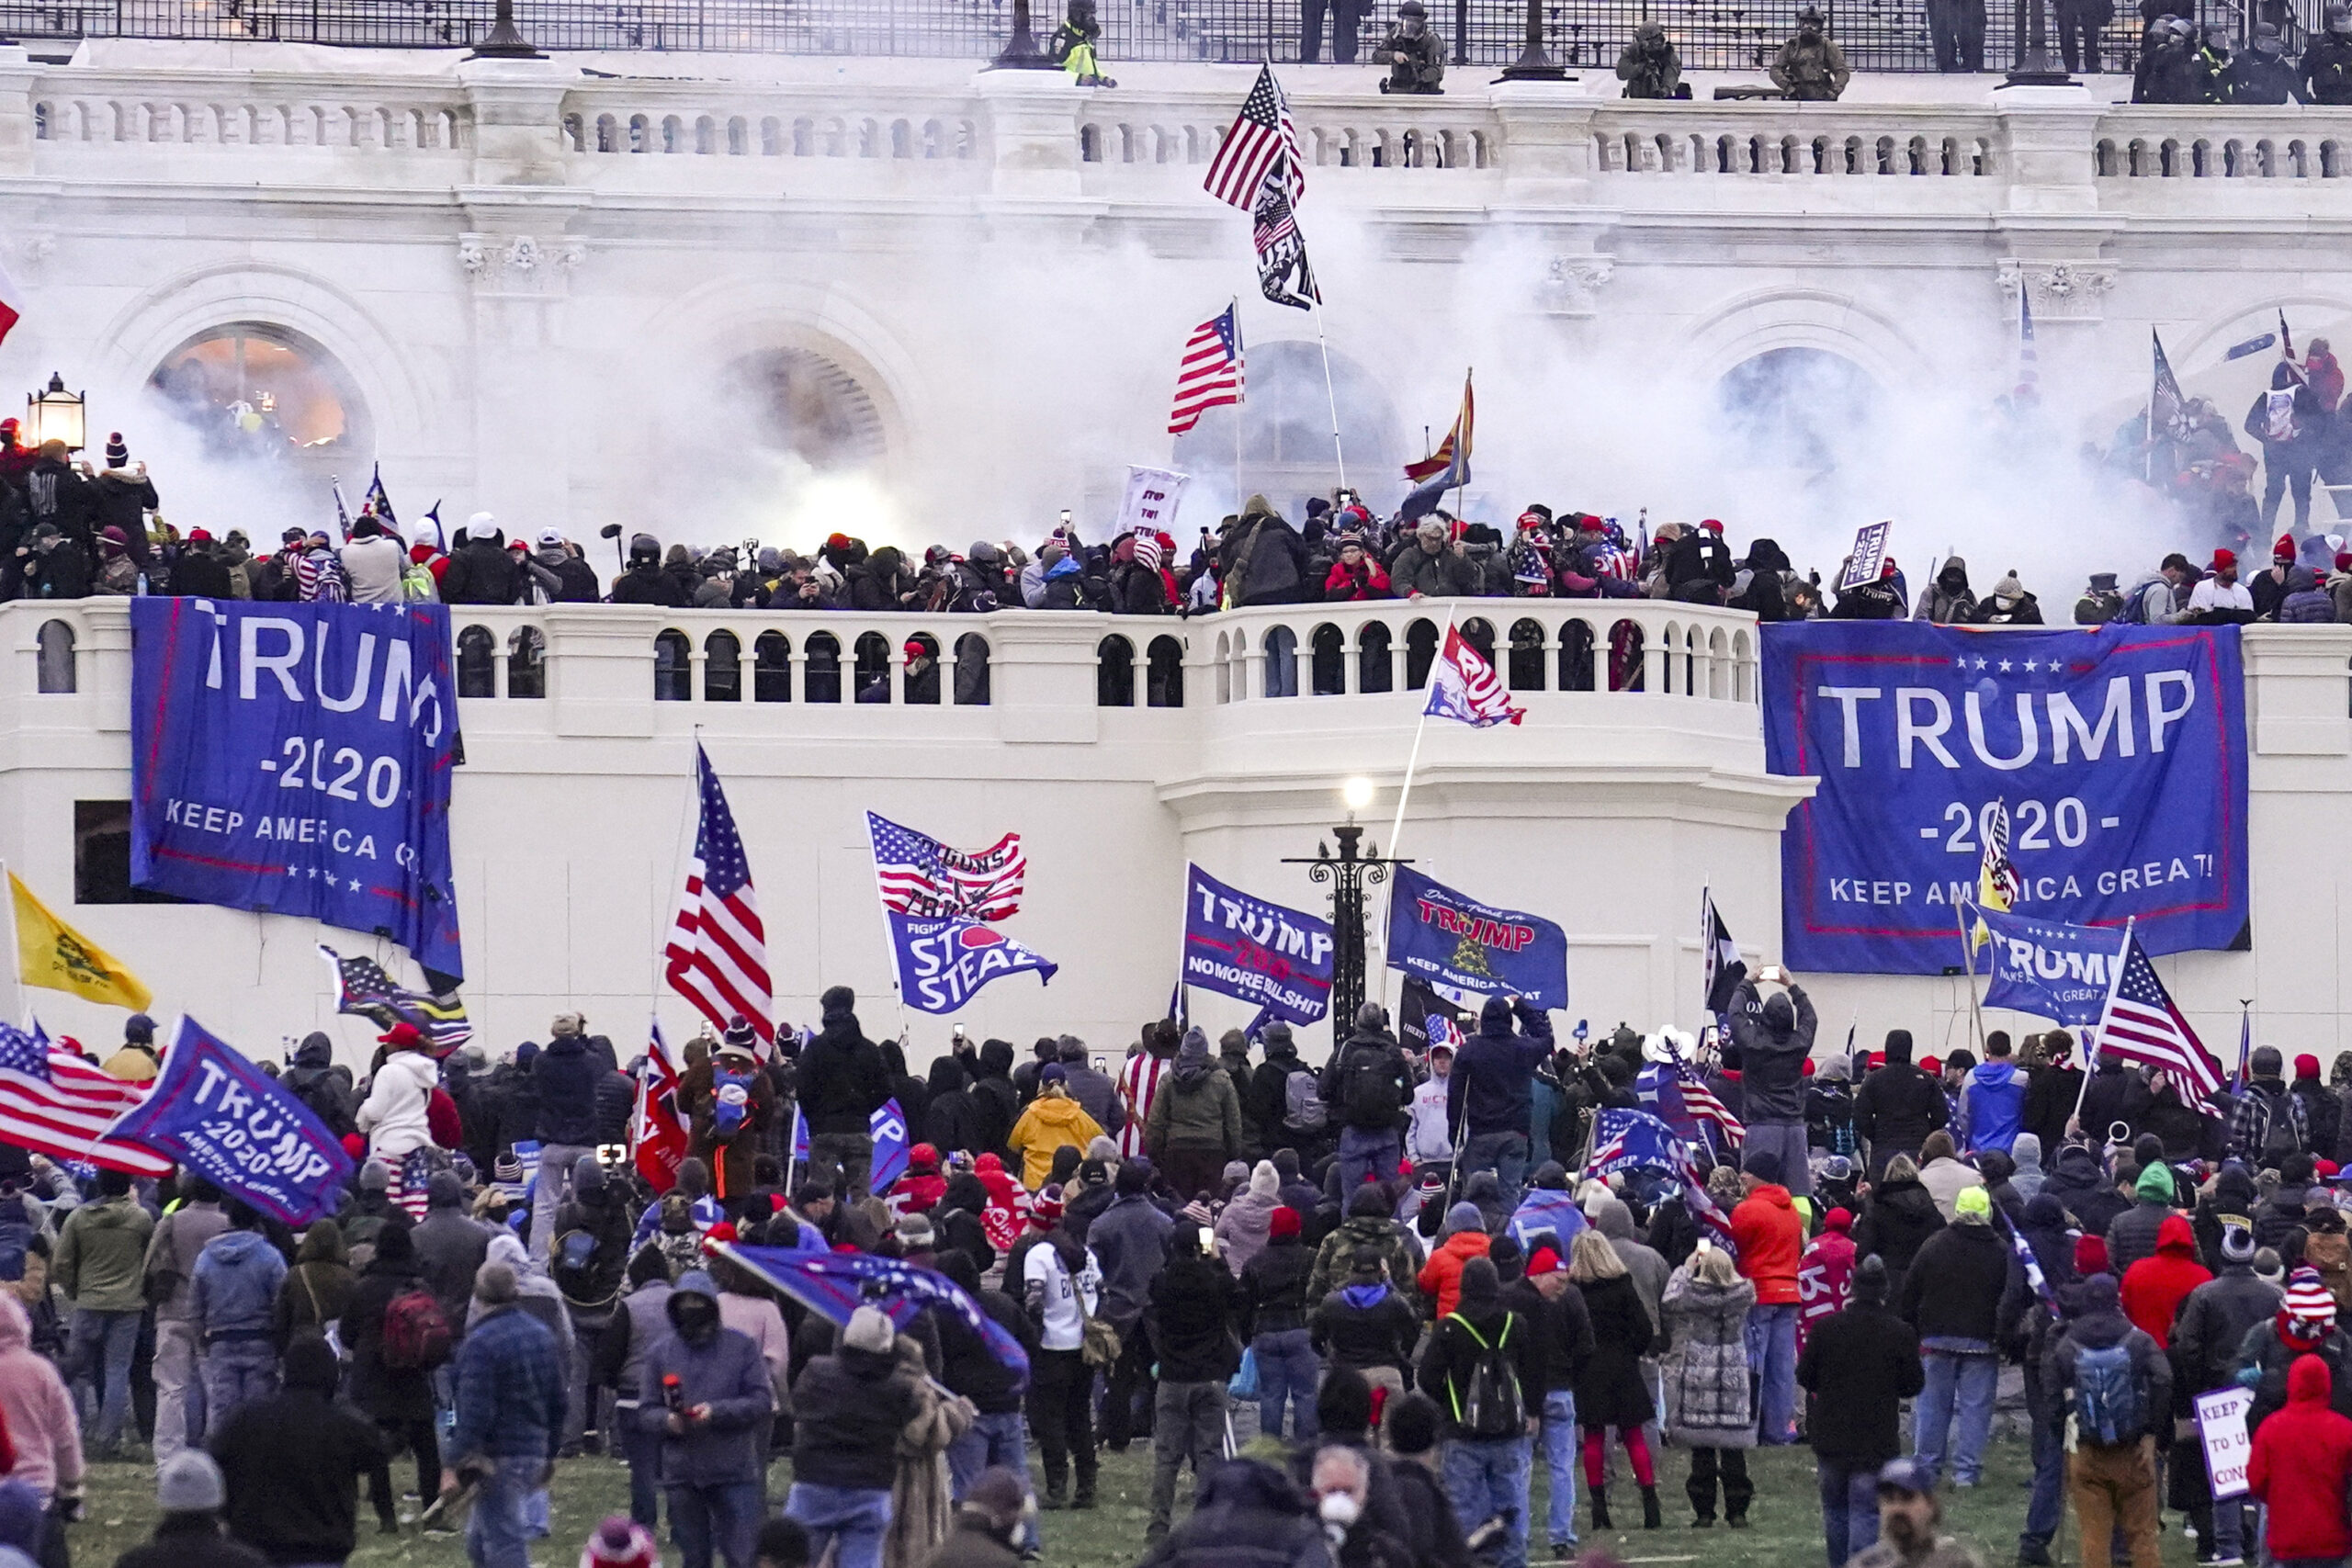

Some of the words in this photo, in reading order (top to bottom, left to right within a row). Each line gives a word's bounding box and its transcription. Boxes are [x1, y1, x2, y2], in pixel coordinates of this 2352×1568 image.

[1861, 525, 1885, 579] TRUMP
[1818, 669, 2196, 771] TRUMP
[164, 797, 244, 835] KEEP
[942, 846, 1004, 875] GUNS
[1830, 878, 1912, 905] KEEP
[1926, 874, 2083, 905] AMICA
[2097, 854, 2214, 897] GREAT!
[907, 921, 945, 934] FIGHT
[1196, 882, 1334, 964] TRUMP
[1417, 897, 1534, 953] TRUMP
[1407, 955, 1440, 973] KEEP
[1442, 968, 1498, 989] AMERICA
[1990, 929, 2119, 986] TRUM
[1189, 956, 1215, 976] NO
[1215, 964, 1263, 990] MORE
[1264, 976, 1324, 1017] BULLSHIT
[2063, 988, 2099, 1002] GREAT
[179, 1131, 244, 1184] AMERICA
[1597, 1155, 1638, 1177] KEEP
[2201, 1401, 2238, 1421] KEEP
[2210, 1437, 2230, 1452] TO
